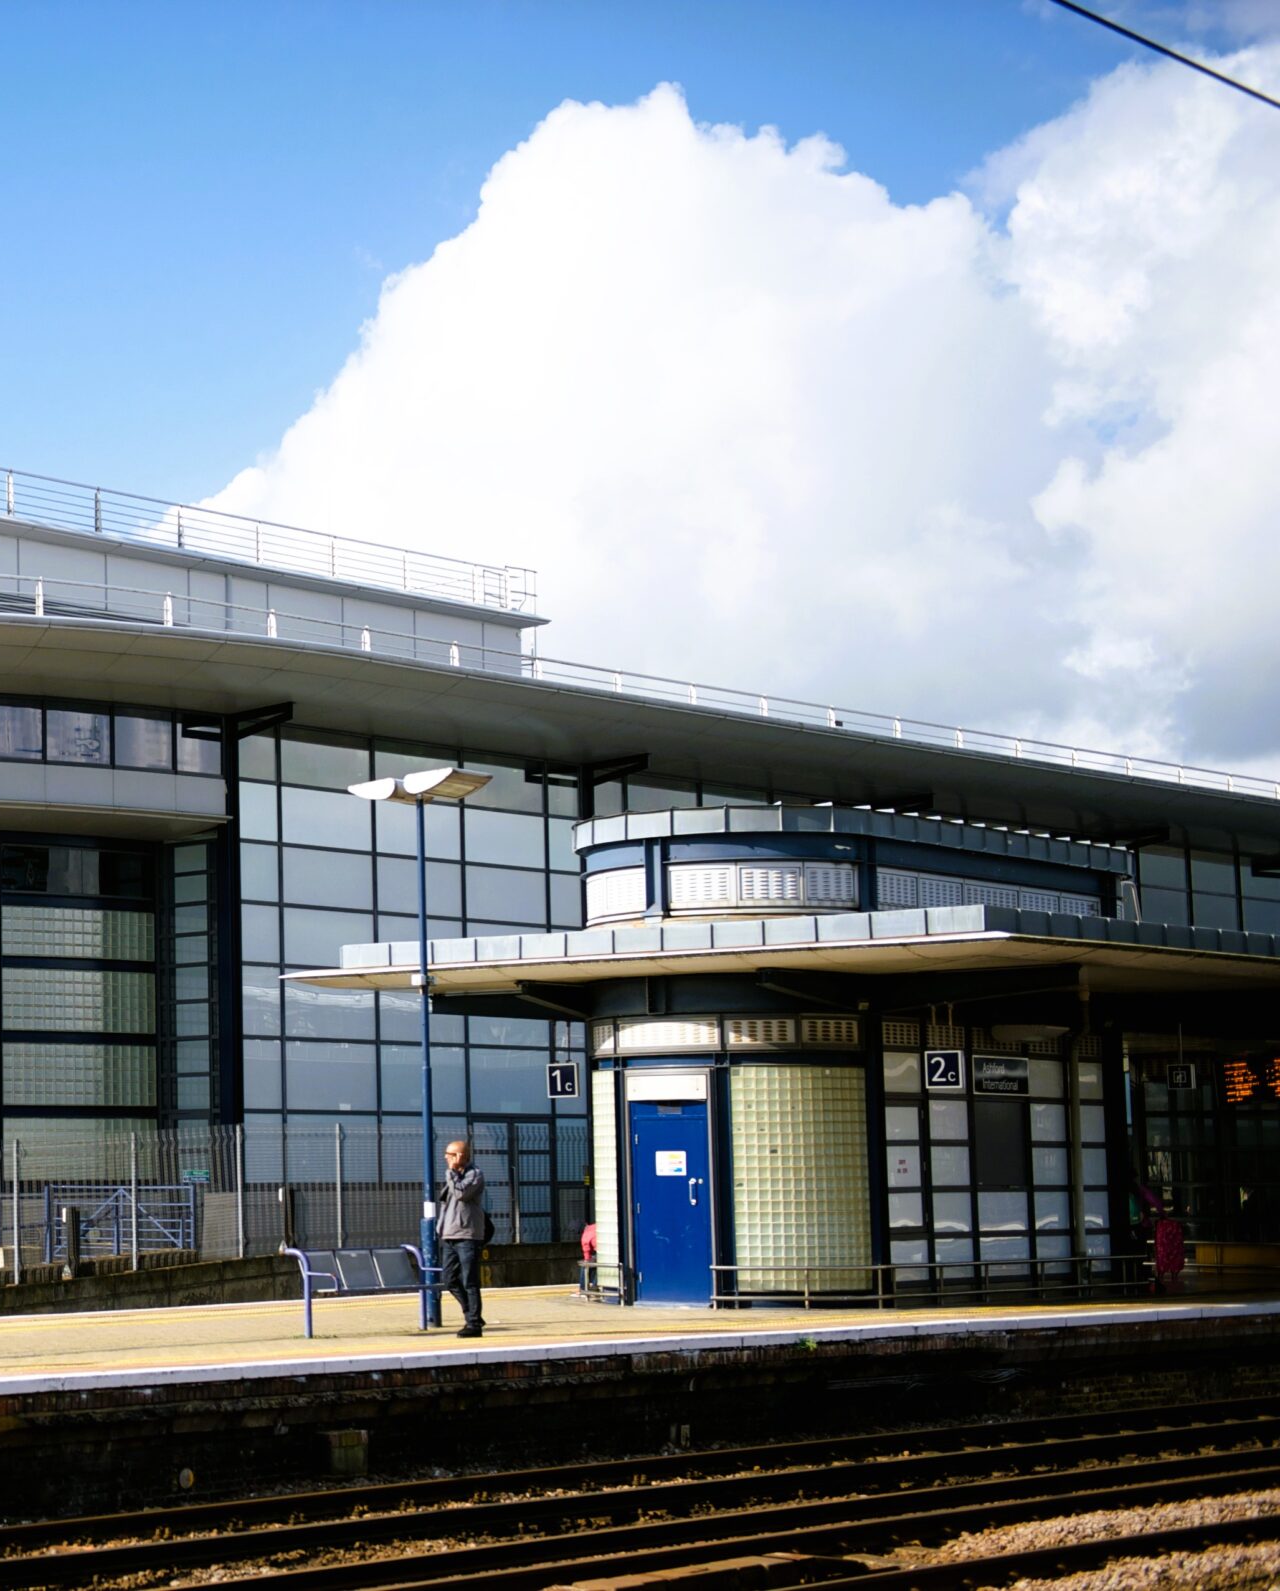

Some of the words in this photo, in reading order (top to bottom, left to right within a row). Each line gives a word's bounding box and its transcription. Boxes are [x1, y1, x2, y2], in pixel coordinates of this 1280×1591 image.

[930, 1056, 957, 1082] 2c
[982, 1062, 1006, 1074] Ashford
[551, 1069, 573, 1092] 1c
[982, 1078, 1019, 1091] International
